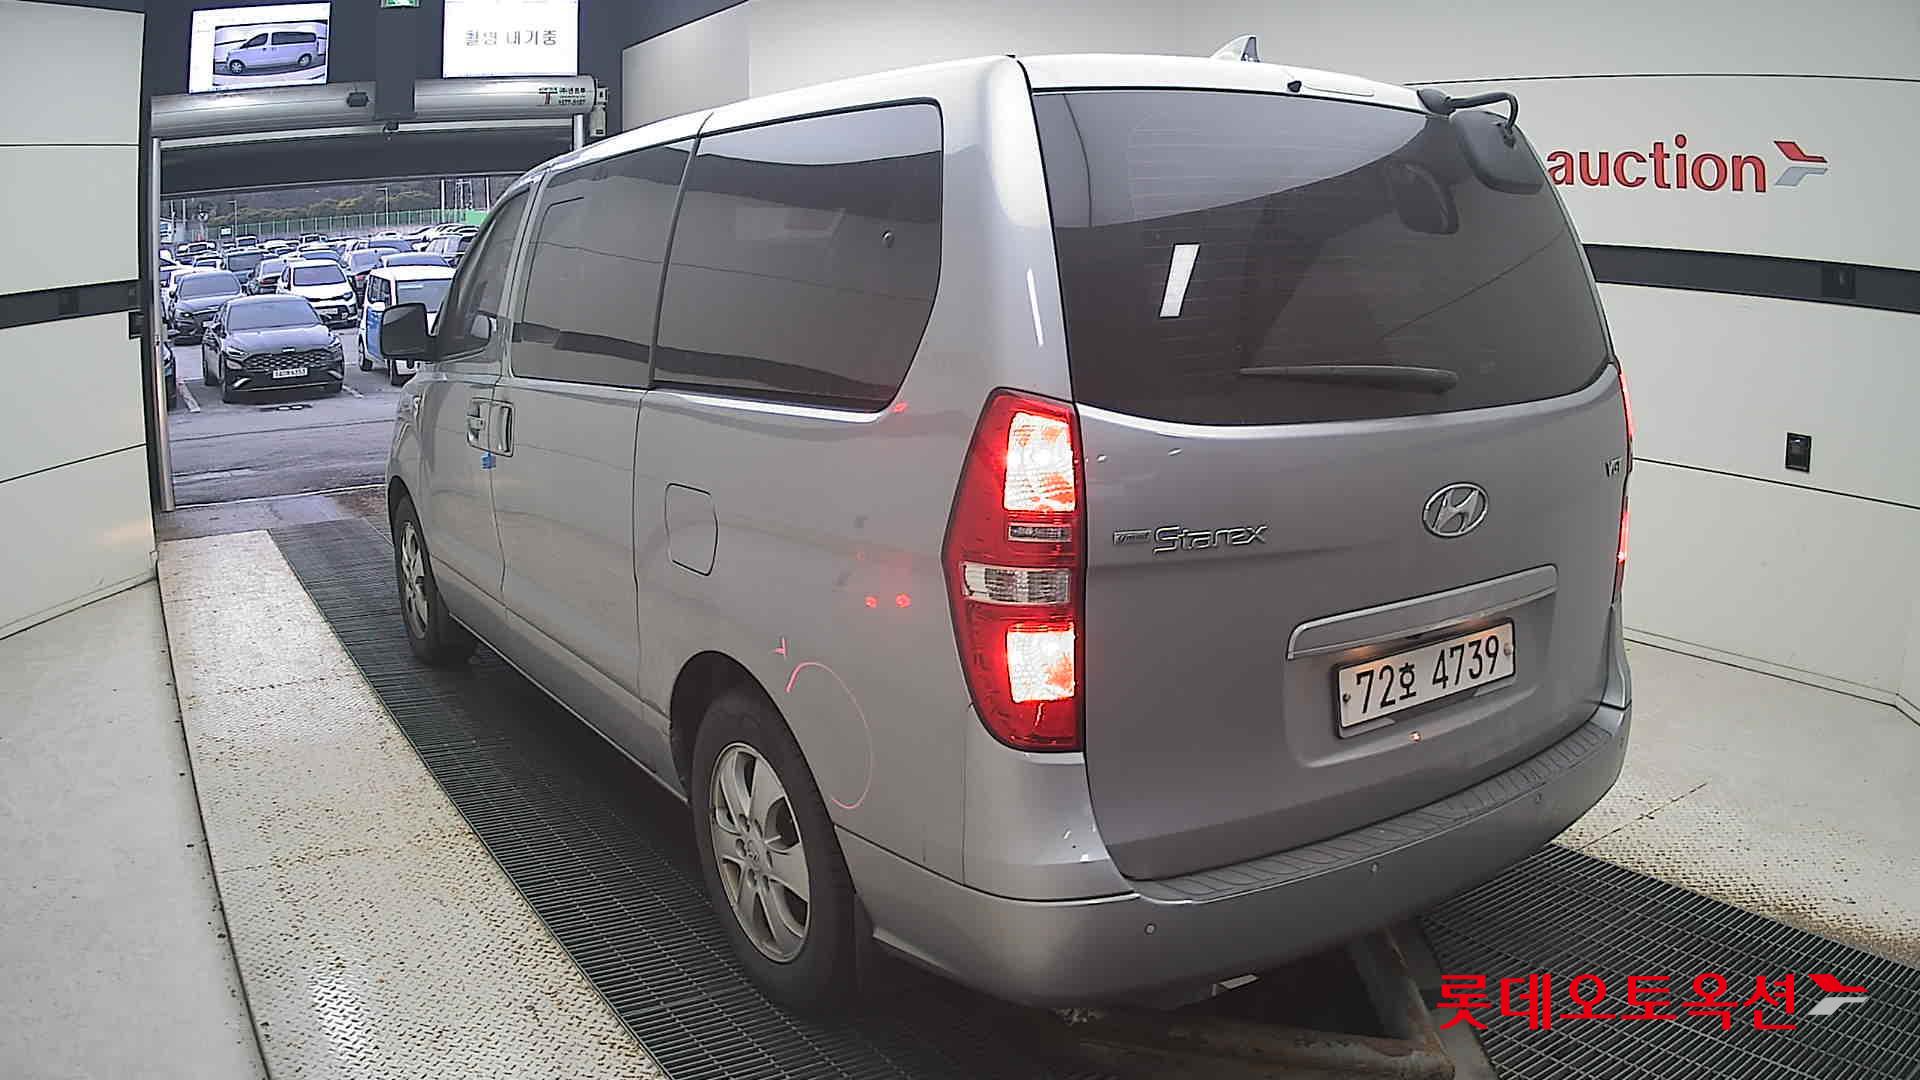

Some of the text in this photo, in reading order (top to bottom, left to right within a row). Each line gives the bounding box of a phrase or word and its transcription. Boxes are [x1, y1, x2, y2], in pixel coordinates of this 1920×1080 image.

[1547, 134, 1767, 192] auction
[1153, 525, 1267, 554] Starex
[1356, 635, 1499, 714] 72호 4739
